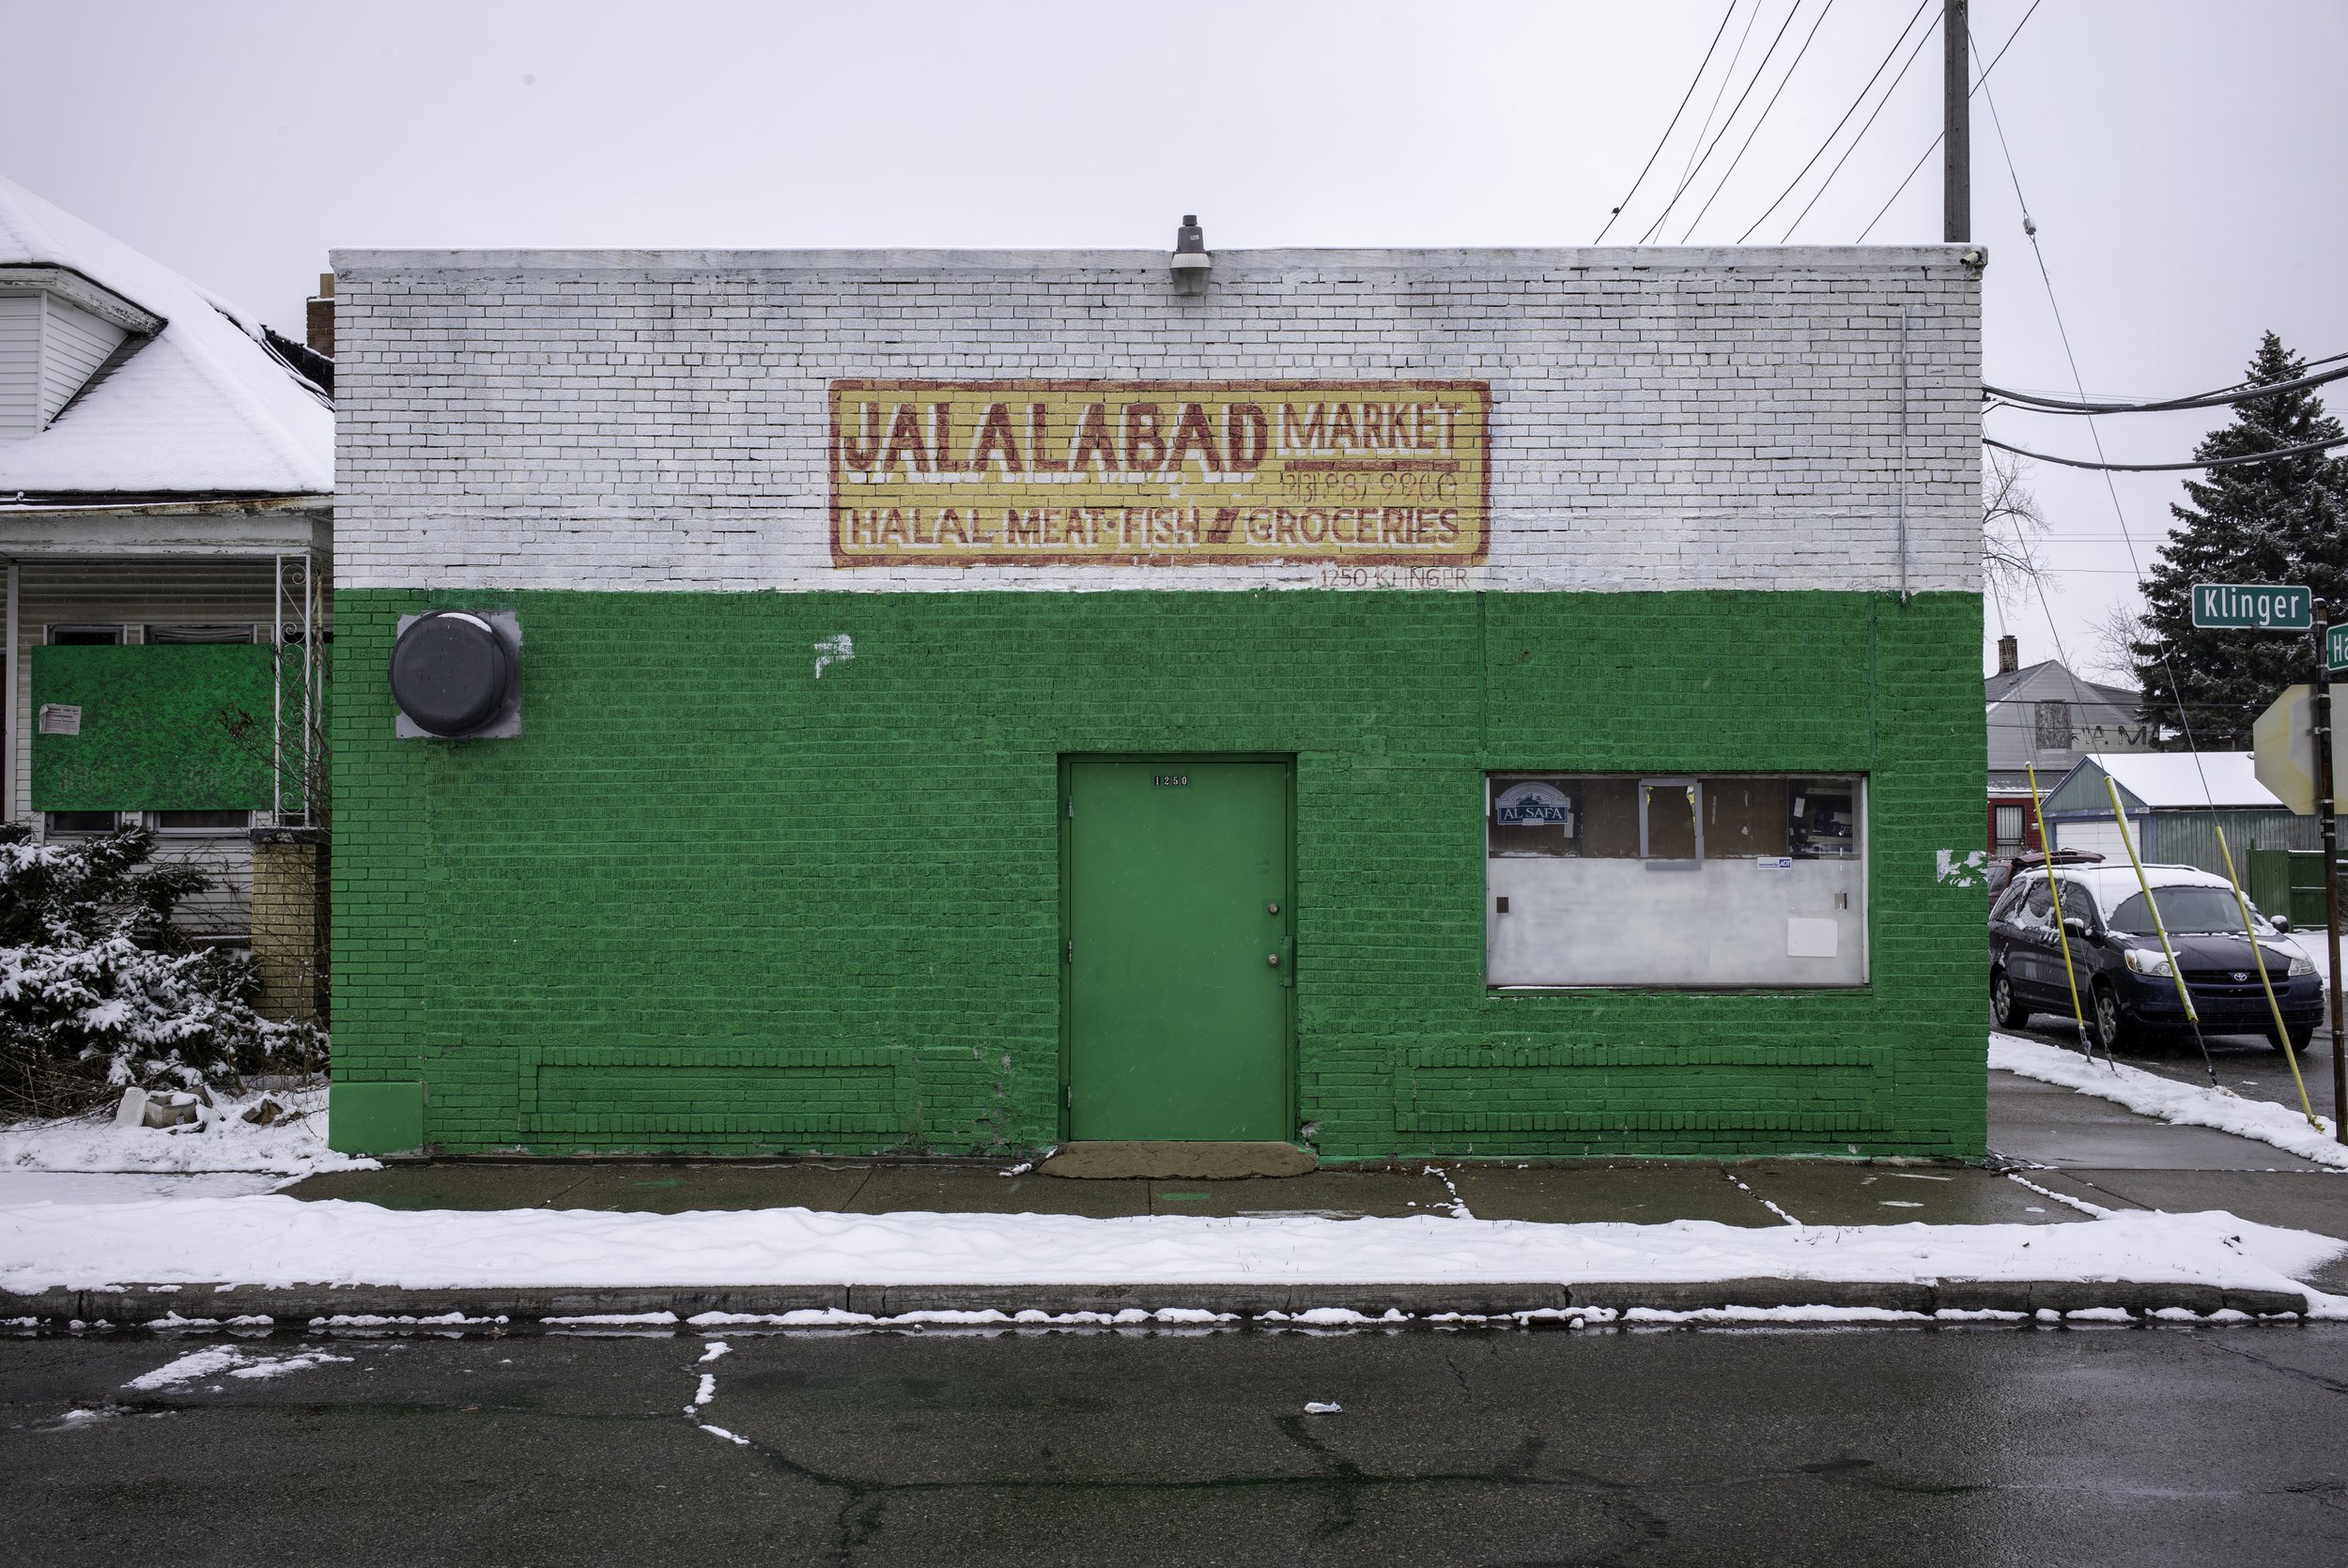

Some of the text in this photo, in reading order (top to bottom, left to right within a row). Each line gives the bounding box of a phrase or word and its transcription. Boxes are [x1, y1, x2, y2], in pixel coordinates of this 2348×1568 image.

[842, 402, 1462, 482] JALALABAD MARKET
[846, 508, 995, 548] HALAL
[1245, 508, 1460, 548] GROCERIES
[1321, 568, 1367, 587] 1250
[2204, 587, 2299, 625] Klinger
[1154, 776, 1187, 786] 1250
[1503, 807, 1563, 820] AL SAFA
[1780, 859, 1791, 868] ADT
